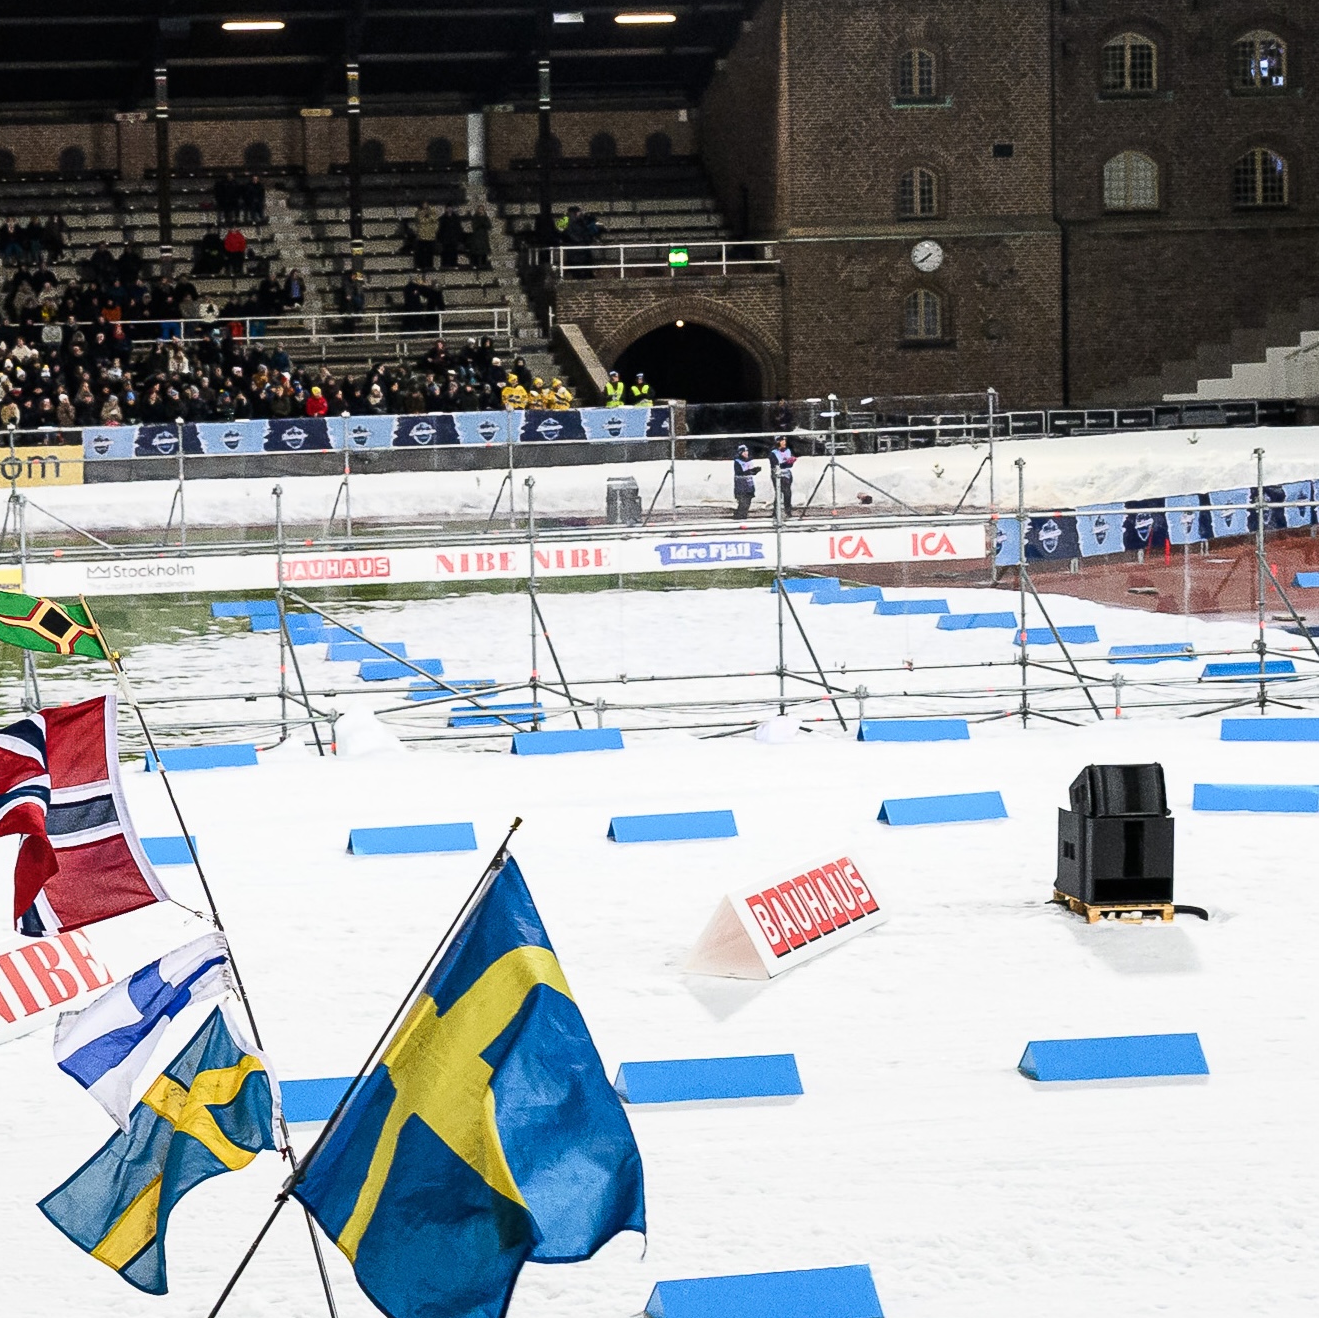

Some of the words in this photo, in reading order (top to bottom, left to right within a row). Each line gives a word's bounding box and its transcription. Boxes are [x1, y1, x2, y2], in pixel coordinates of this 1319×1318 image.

[829, 536, 873, 559] ICA
[912, 532, 956, 556] ICA
[113, 563, 195, 578] Stockholm
[277, 557, 390, 581] BAUHAUS
[435, 551, 517, 574] NIBE
[533, 548, 611, 570] NIBE
[751, 863, 871, 946] BAUHAUS
